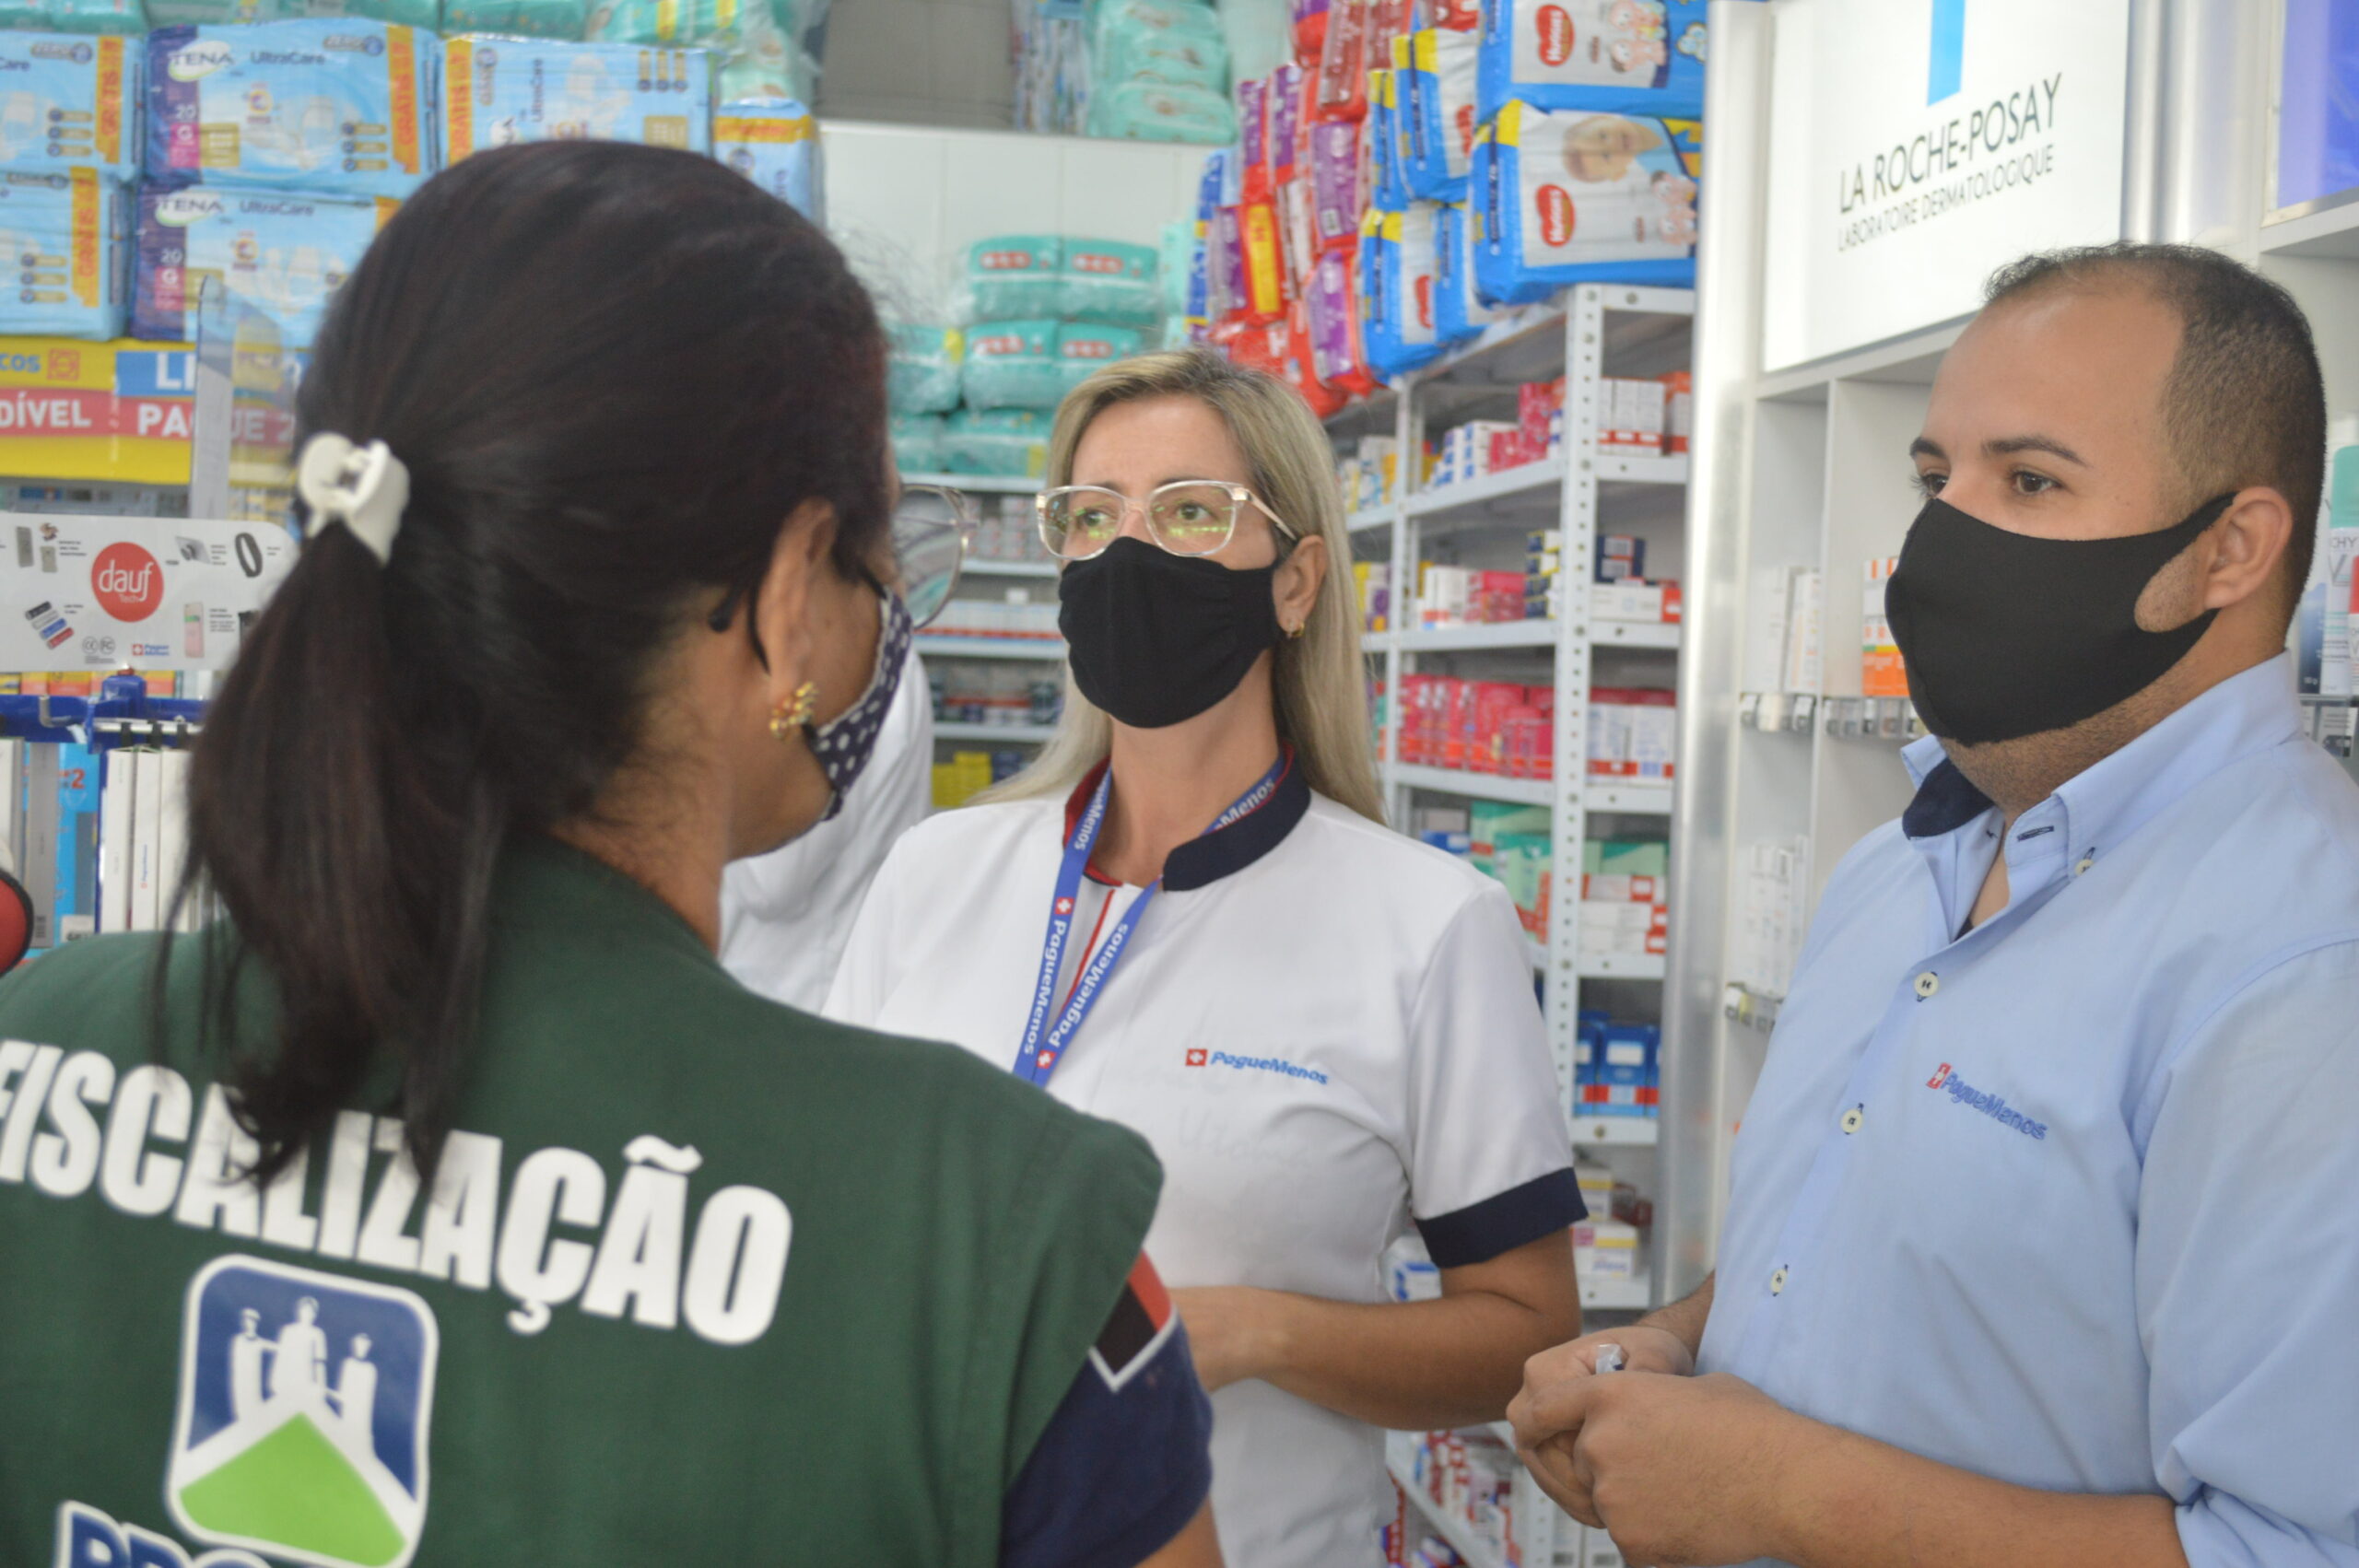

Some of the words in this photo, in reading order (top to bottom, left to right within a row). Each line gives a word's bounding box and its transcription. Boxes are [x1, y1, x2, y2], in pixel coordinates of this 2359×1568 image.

[169, 52, 233, 65] TENA
[1840, 162, 1866, 215] LA
[1872, 72, 2062, 202] ROCHE-POSAY
[156, 196, 224, 213] TENA
[1837, 197, 1919, 252] LABORATOIRE
[1922, 144, 2055, 220] DERMATOLOGIQUE
[1215, 778, 1275, 830] Menos
[1024, 919, 1067, 1055] PagueMenos
[1048, 923, 1129, 1047] PagueMenos
[1210, 1050, 1329, 1085] PagueMenos
[1939, 1071, 2048, 1141] PagueMenos
